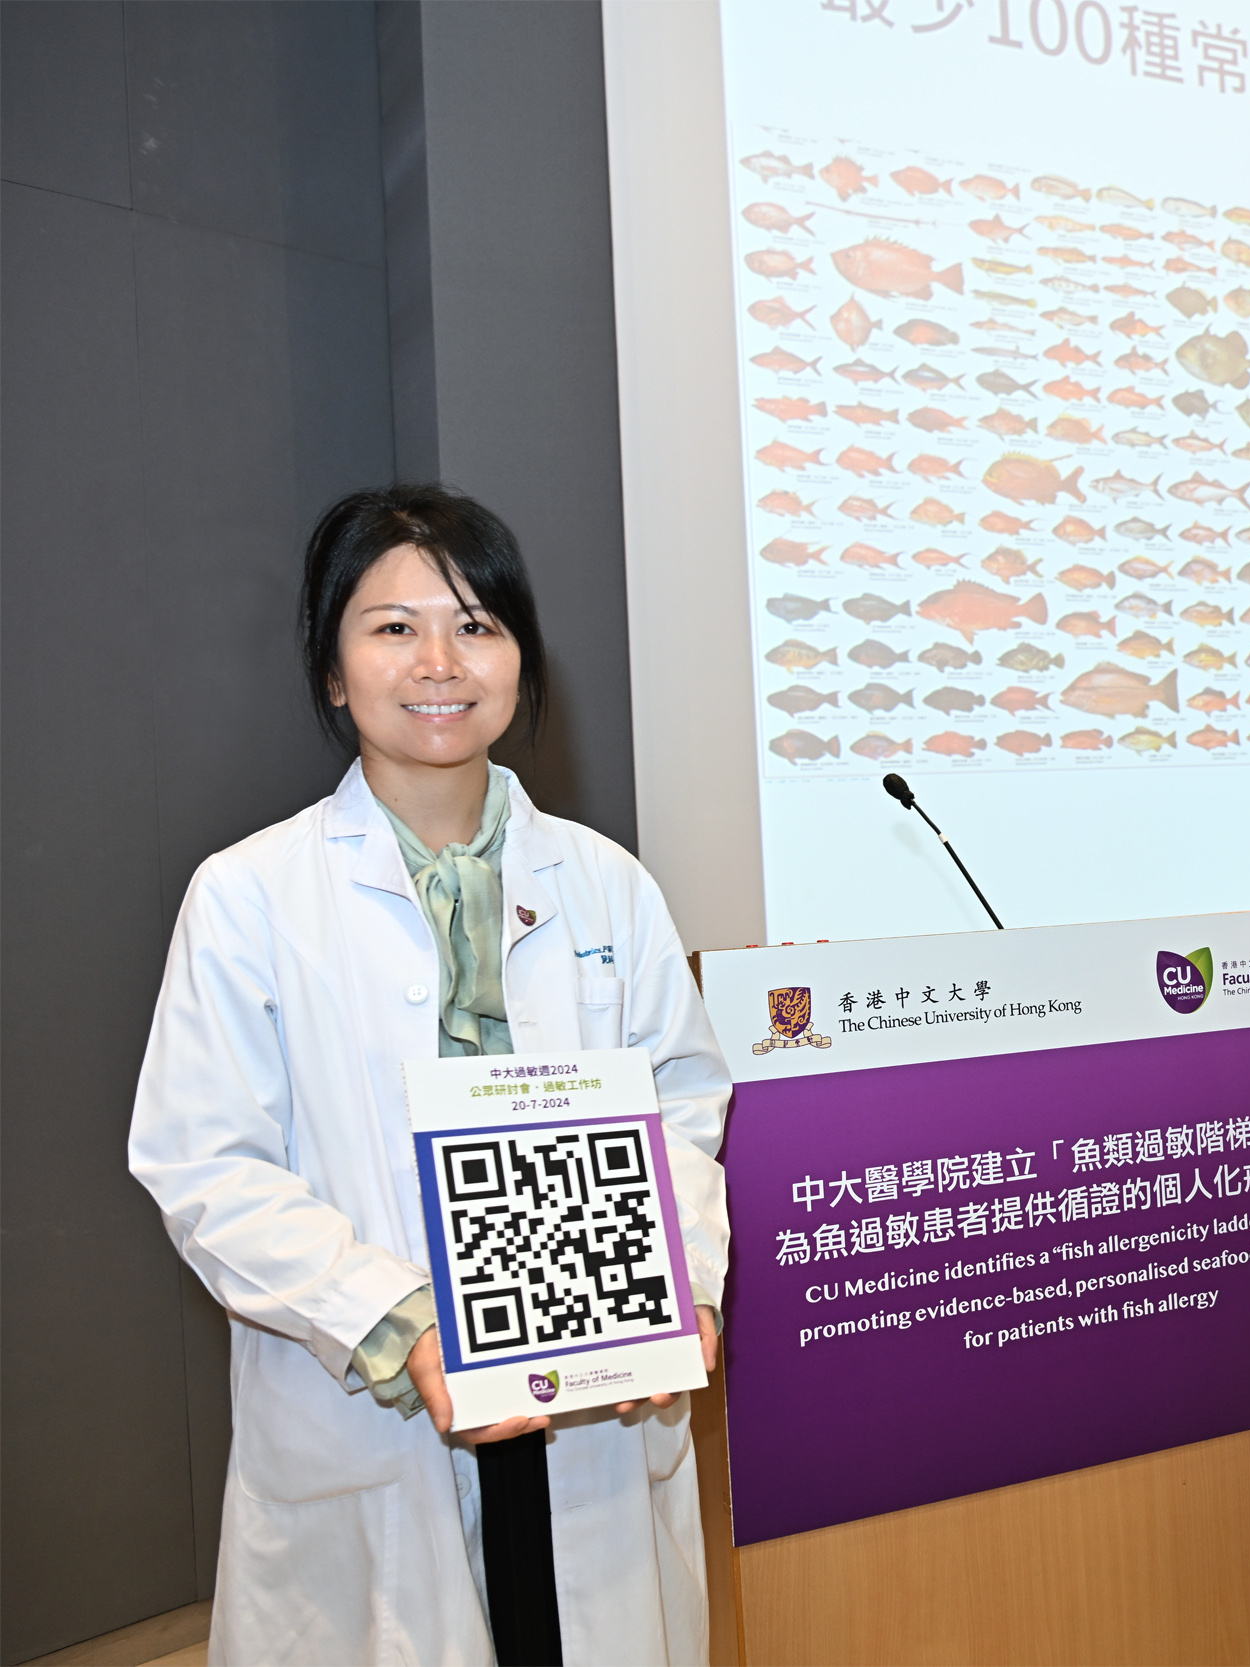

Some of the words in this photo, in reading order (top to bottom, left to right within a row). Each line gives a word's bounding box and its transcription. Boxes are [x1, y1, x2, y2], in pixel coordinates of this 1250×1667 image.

[1163, 966, 1192, 985] CU
[838, 980, 992, 1013] 香港中文大學
[1163, 984, 1204, 996] Medicine
[1223, 988, 1236, 996] The
[839, 1018, 866, 1033] The
[867, 1015, 922, 1030] Chinese
[925, 1007, 993, 1024] University
[993, 1004, 1009, 1018] of
[1010, 1002, 1046, 1018] Hong
[1048, 1000, 1082, 1014] Kong
[490, 1064, 578, 1079] 中大過敏週2024
[512, 1097, 570, 1111] 20-7-2024
[805, 1283, 839, 1303] CU
[845, 1268, 940, 1297] Medicine
[944, 1253, 1035, 1281] identifies
[1039, 1251, 1050, 1264] a
[1052, 1238, 1094, 1261] “fish
[1098, 1222, 1209, 1254] allergenicity
[800, 1310, 912, 1347] promoting
[915, 1278, 1073, 1322] evidence-based,
[1076, 1257, 1189, 1297] personalised
[964, 1330, 994, 1349] for
[998, 1315, 1074, 1347] patients
[1078, 1306, 1119, 1328] with
[1122, 1300, 1155, 1319] fish
[1158, 1289, 1219, 1312] allergy
[531, 1379, 549, 1391] CU
[565, 1379, 590, 1388] Faculty
[601, 1371, 632, 1381] Medicine
